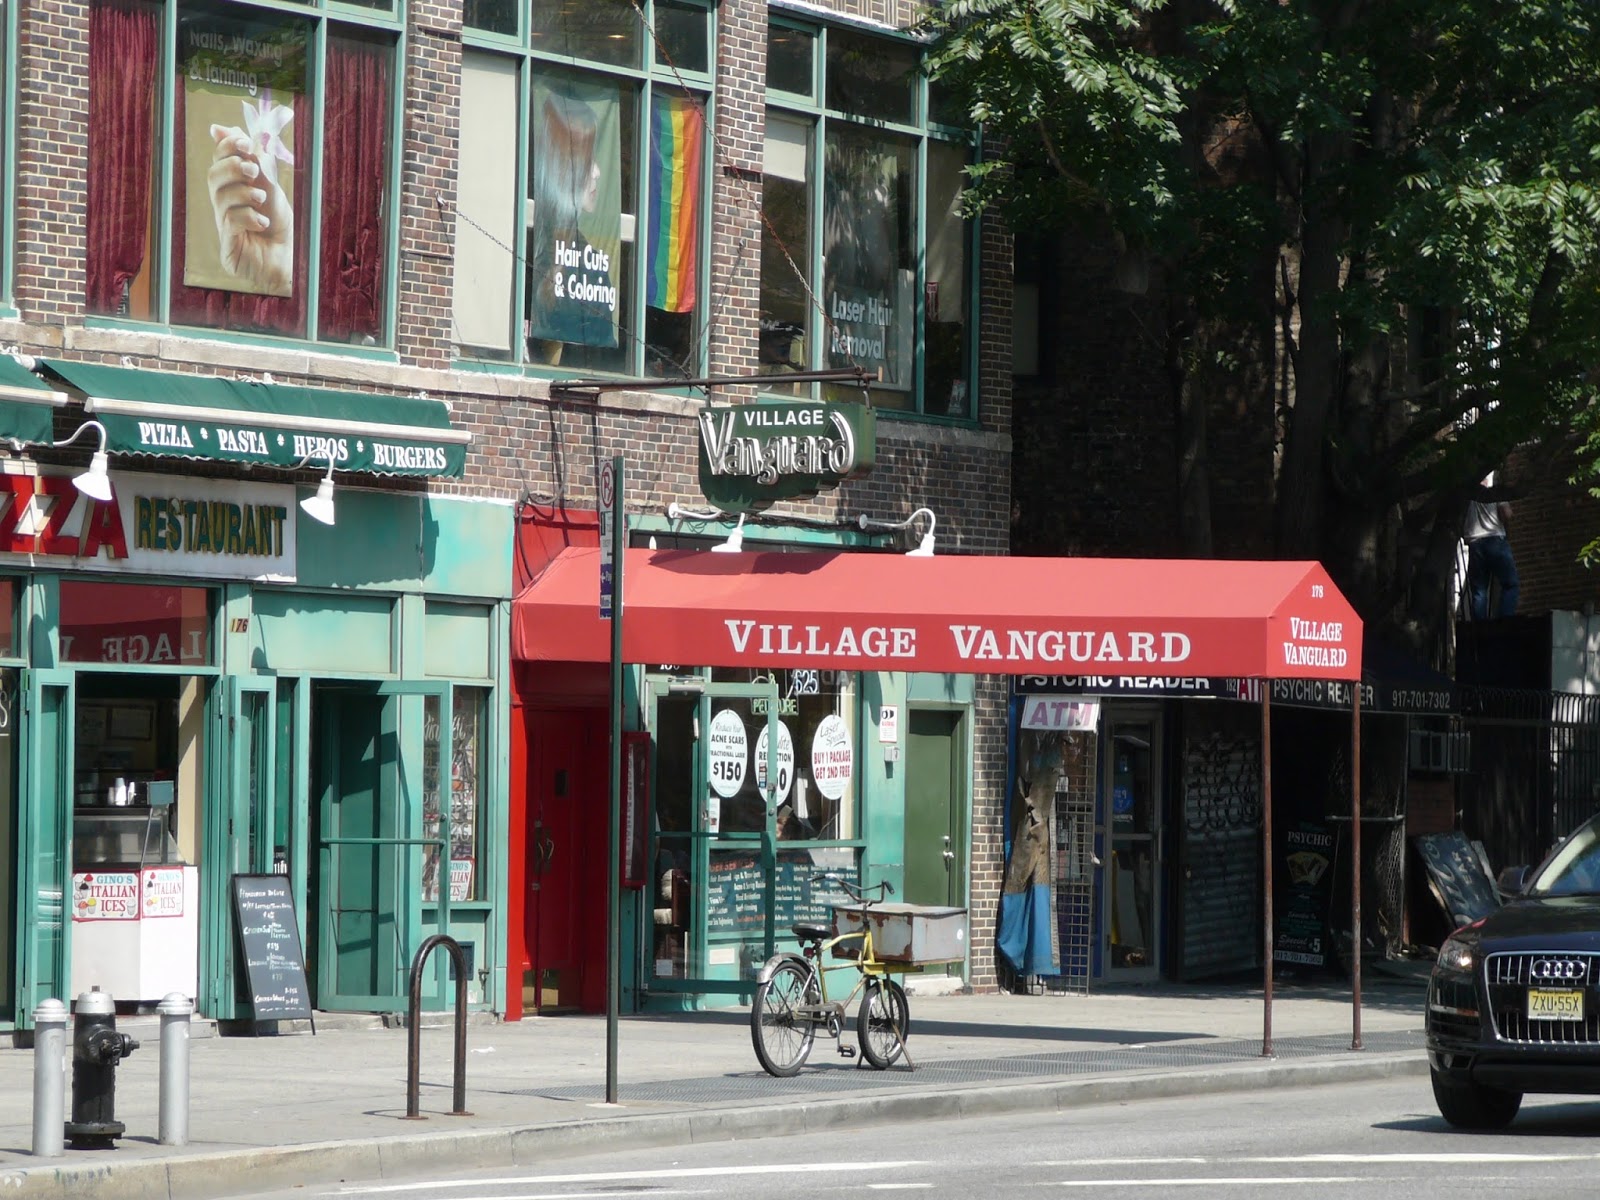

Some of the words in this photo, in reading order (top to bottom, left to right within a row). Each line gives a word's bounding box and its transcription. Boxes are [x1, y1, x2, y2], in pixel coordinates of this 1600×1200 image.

[231, 37, 281, 66] Waxing
[190, 56, 202, 79] &
[204, 63, 257, 95] Tanning
[555, 240, 582, 266] Hair
[584, 245, 609, 272] Cuts
[554, 272, 565, 297] &
[567, 274, 616, 312] Coloring
[832, 298, 865, 323] Laser
[868, 298, 892, 326] Hair
[832, 331, 886, 360] Removal
[743, 410, 823, 426] VILLAGE
[138, 422, 193, 448] PIZZA
[216, 428, 269, 454] PASTA
[293, 436, 348, 461] HEROS
[373, 443, 447, 469] BURGERS
[698, 409, 855, 485] Vanguard
[134, 496, 287, 557] RESTAURANT
[1312, 585, 1324, 598] 178
[230, 618, 248, 632] 176
[1290, 617, 1342, 642] VILLAGE
[725, 620, 916, 657] VILLAGE
[950, 625, 1191, 662] VANGUARD
[1284, 642, 1347, 667] VANGUARD
[1274, 679, 1321, 702] PSYCHIC
[1327, 683, 1374, 706] REAER
[1392, 690, 1450, 710] 917-701-7302
[1028, 702, 1093, 727] ATM
[820, 722, 839, 737] Laser
[711, 735, 727, 744] ACNE
[728, 736, 744, 745] SCARS
[710, 750, 734, 758] RACTIONAL
[814, 752, 824, 764] BUY
[830, 750, 851, 763] PACKAGE
[713, 761, 741, 781] $150
[815, 768, 826, 780] GET
[828, 767, 838, 779] 2ND
[839, 765, 851, 778] FREE
[1287, 831, 1332, 846] PSYCHIC
[97, 875, 133, 884] GINO'S
[154, 883, 181, 895] ITALIAN
[90, 885, 136, 898] ITALIAN
[101, 900, 126, 912] ICES
[160, 898, 176, 909] ICES
